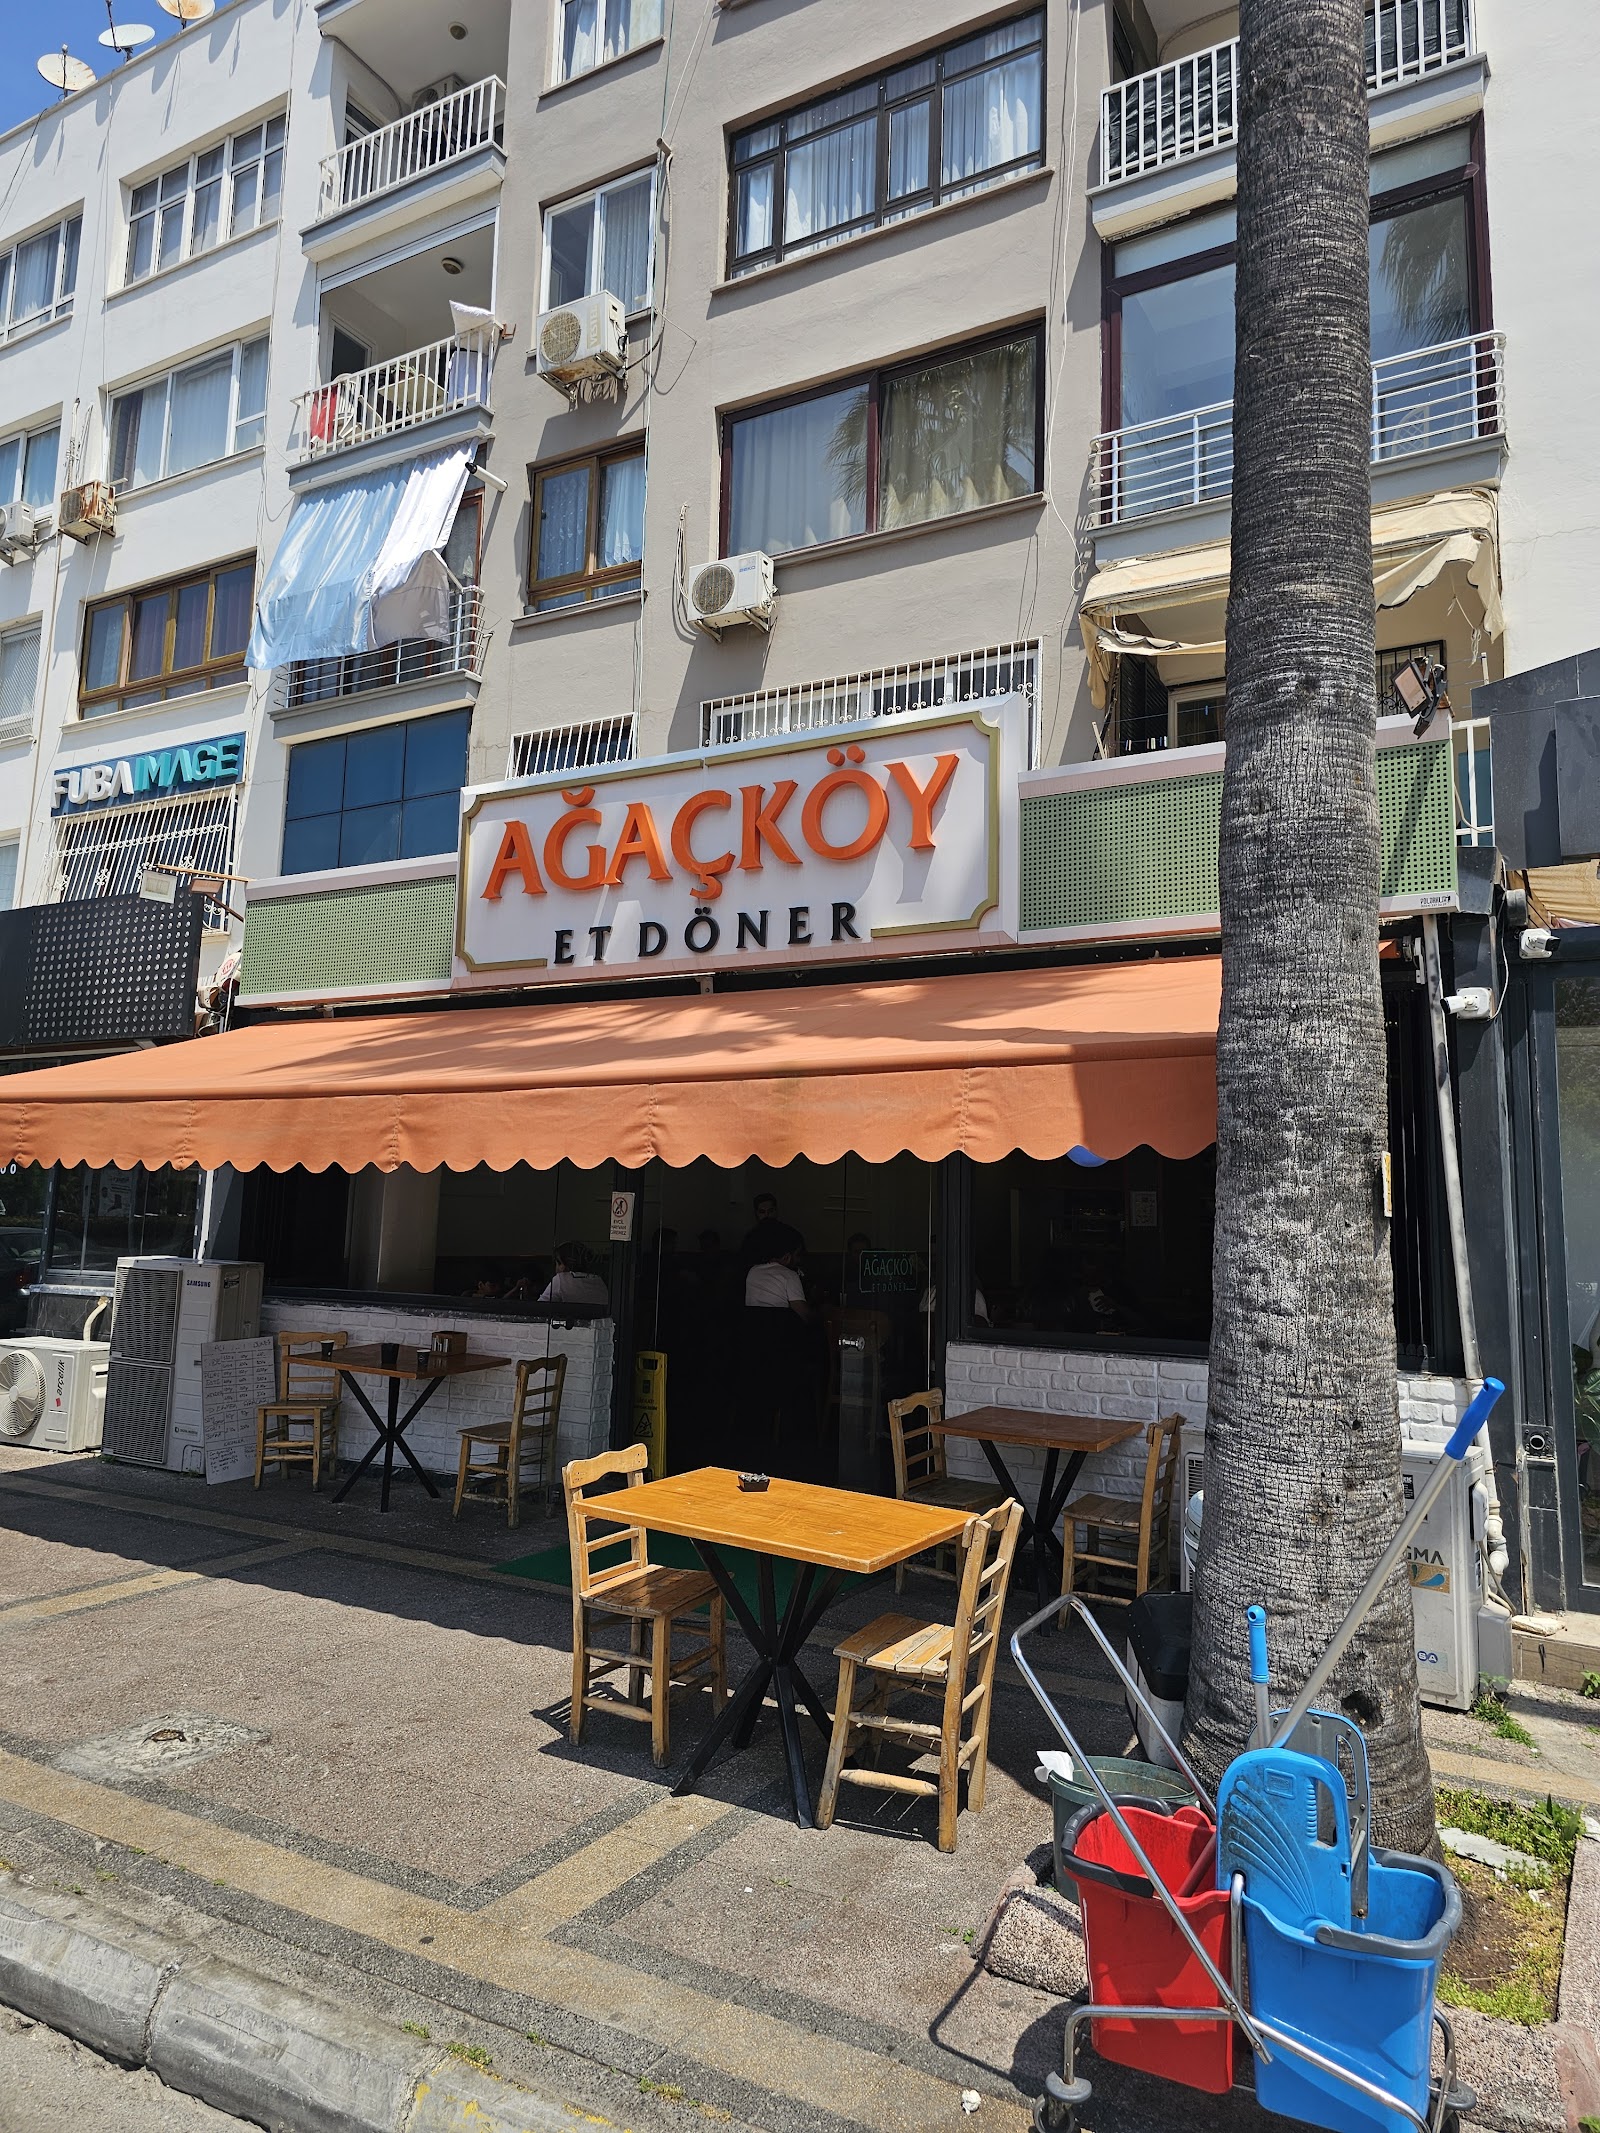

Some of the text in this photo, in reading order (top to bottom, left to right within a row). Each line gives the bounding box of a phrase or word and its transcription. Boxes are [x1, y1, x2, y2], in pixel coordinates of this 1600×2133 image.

[481, 744, 960, 900] AĞAÇKÖY
[553, 902, 861, 965] ET DÖNER
[186, 1279, 211, 1288] SAMSUNG
